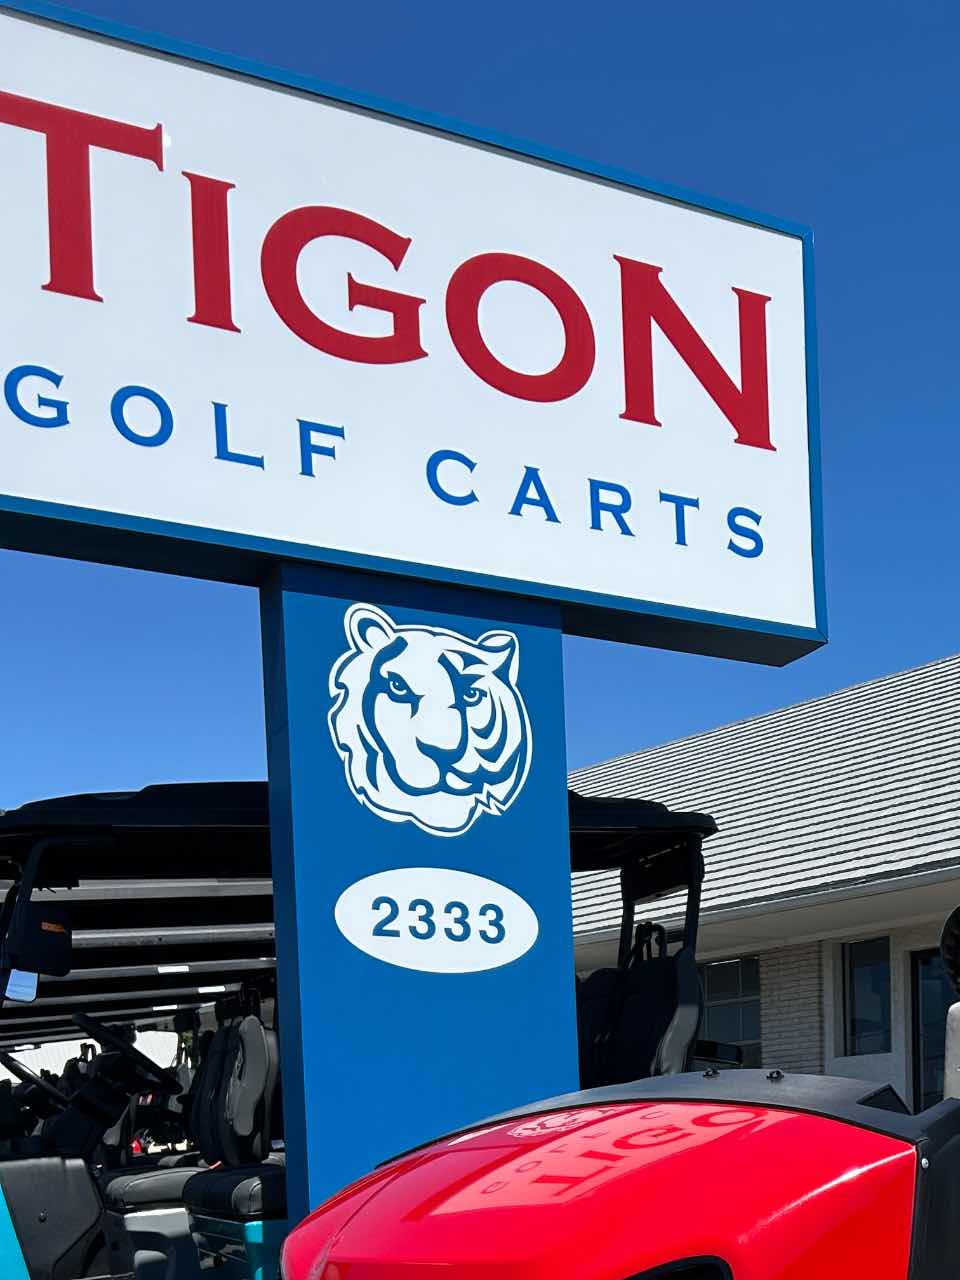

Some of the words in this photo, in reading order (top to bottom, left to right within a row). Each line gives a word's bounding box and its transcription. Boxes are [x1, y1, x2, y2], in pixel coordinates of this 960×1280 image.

[0, 91, 777, 452] TIGON
[4, 364, 346, 478] GOLF
[425, 449, 764, 559] CARTS
[371, 895, 506, 944] 2333
